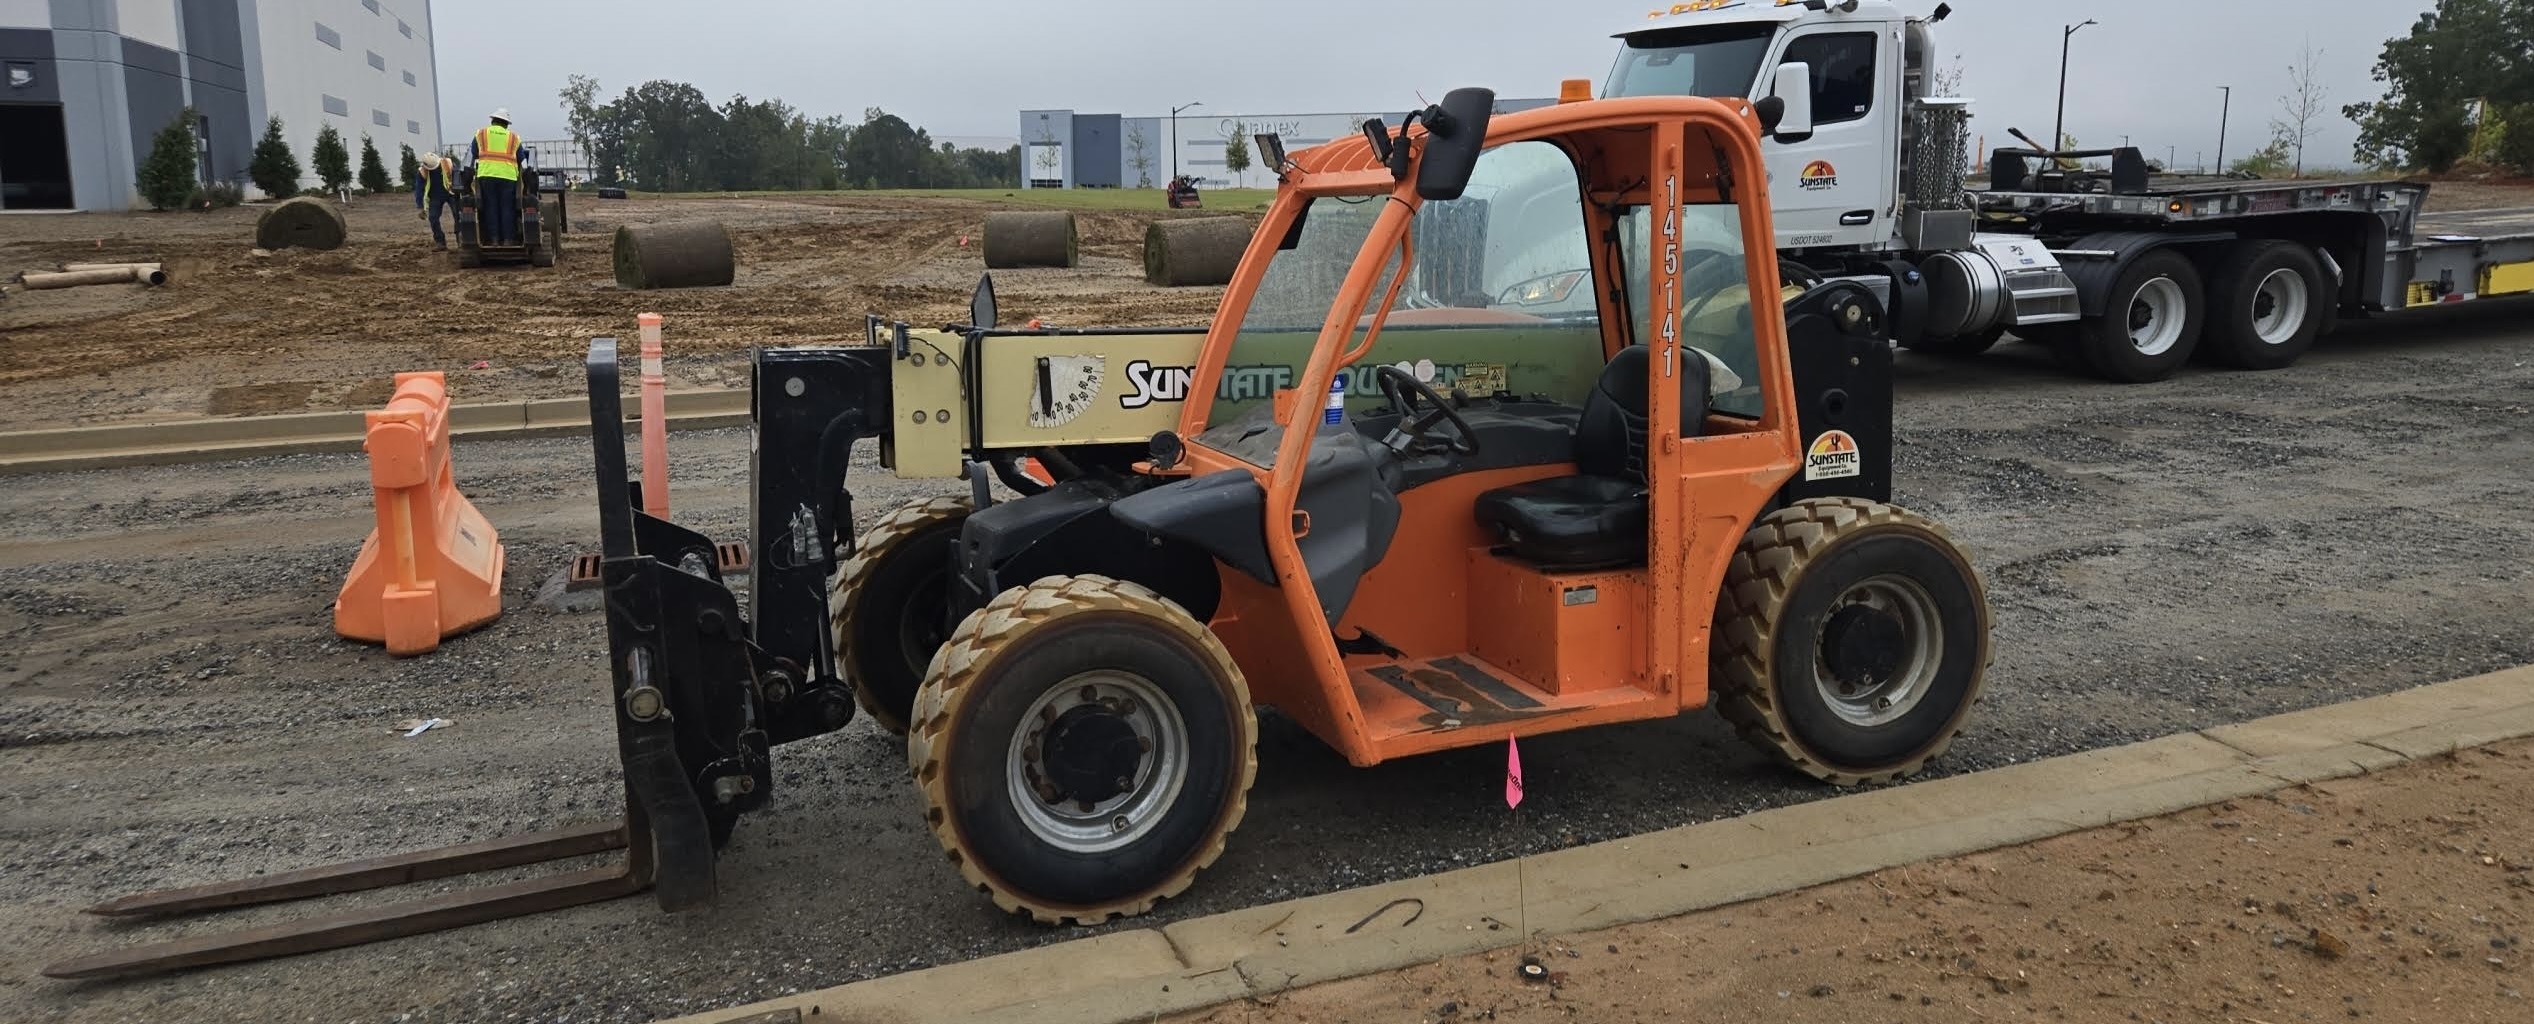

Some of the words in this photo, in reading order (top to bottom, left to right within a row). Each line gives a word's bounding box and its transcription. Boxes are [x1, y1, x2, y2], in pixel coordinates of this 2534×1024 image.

[1217, 118, 1300, 138] Quanex
[1800, 176, 1838, 188] SUNSTATE
[1791, 236, 1811, 246] USDOT
[1662, 174, 1679, 378] 145141
[1119, 360, 1293, 409] SUNTATE
[1055, 400, 1064, 412] 20
[1808, 452, 1857, 467] SUNSTATE
